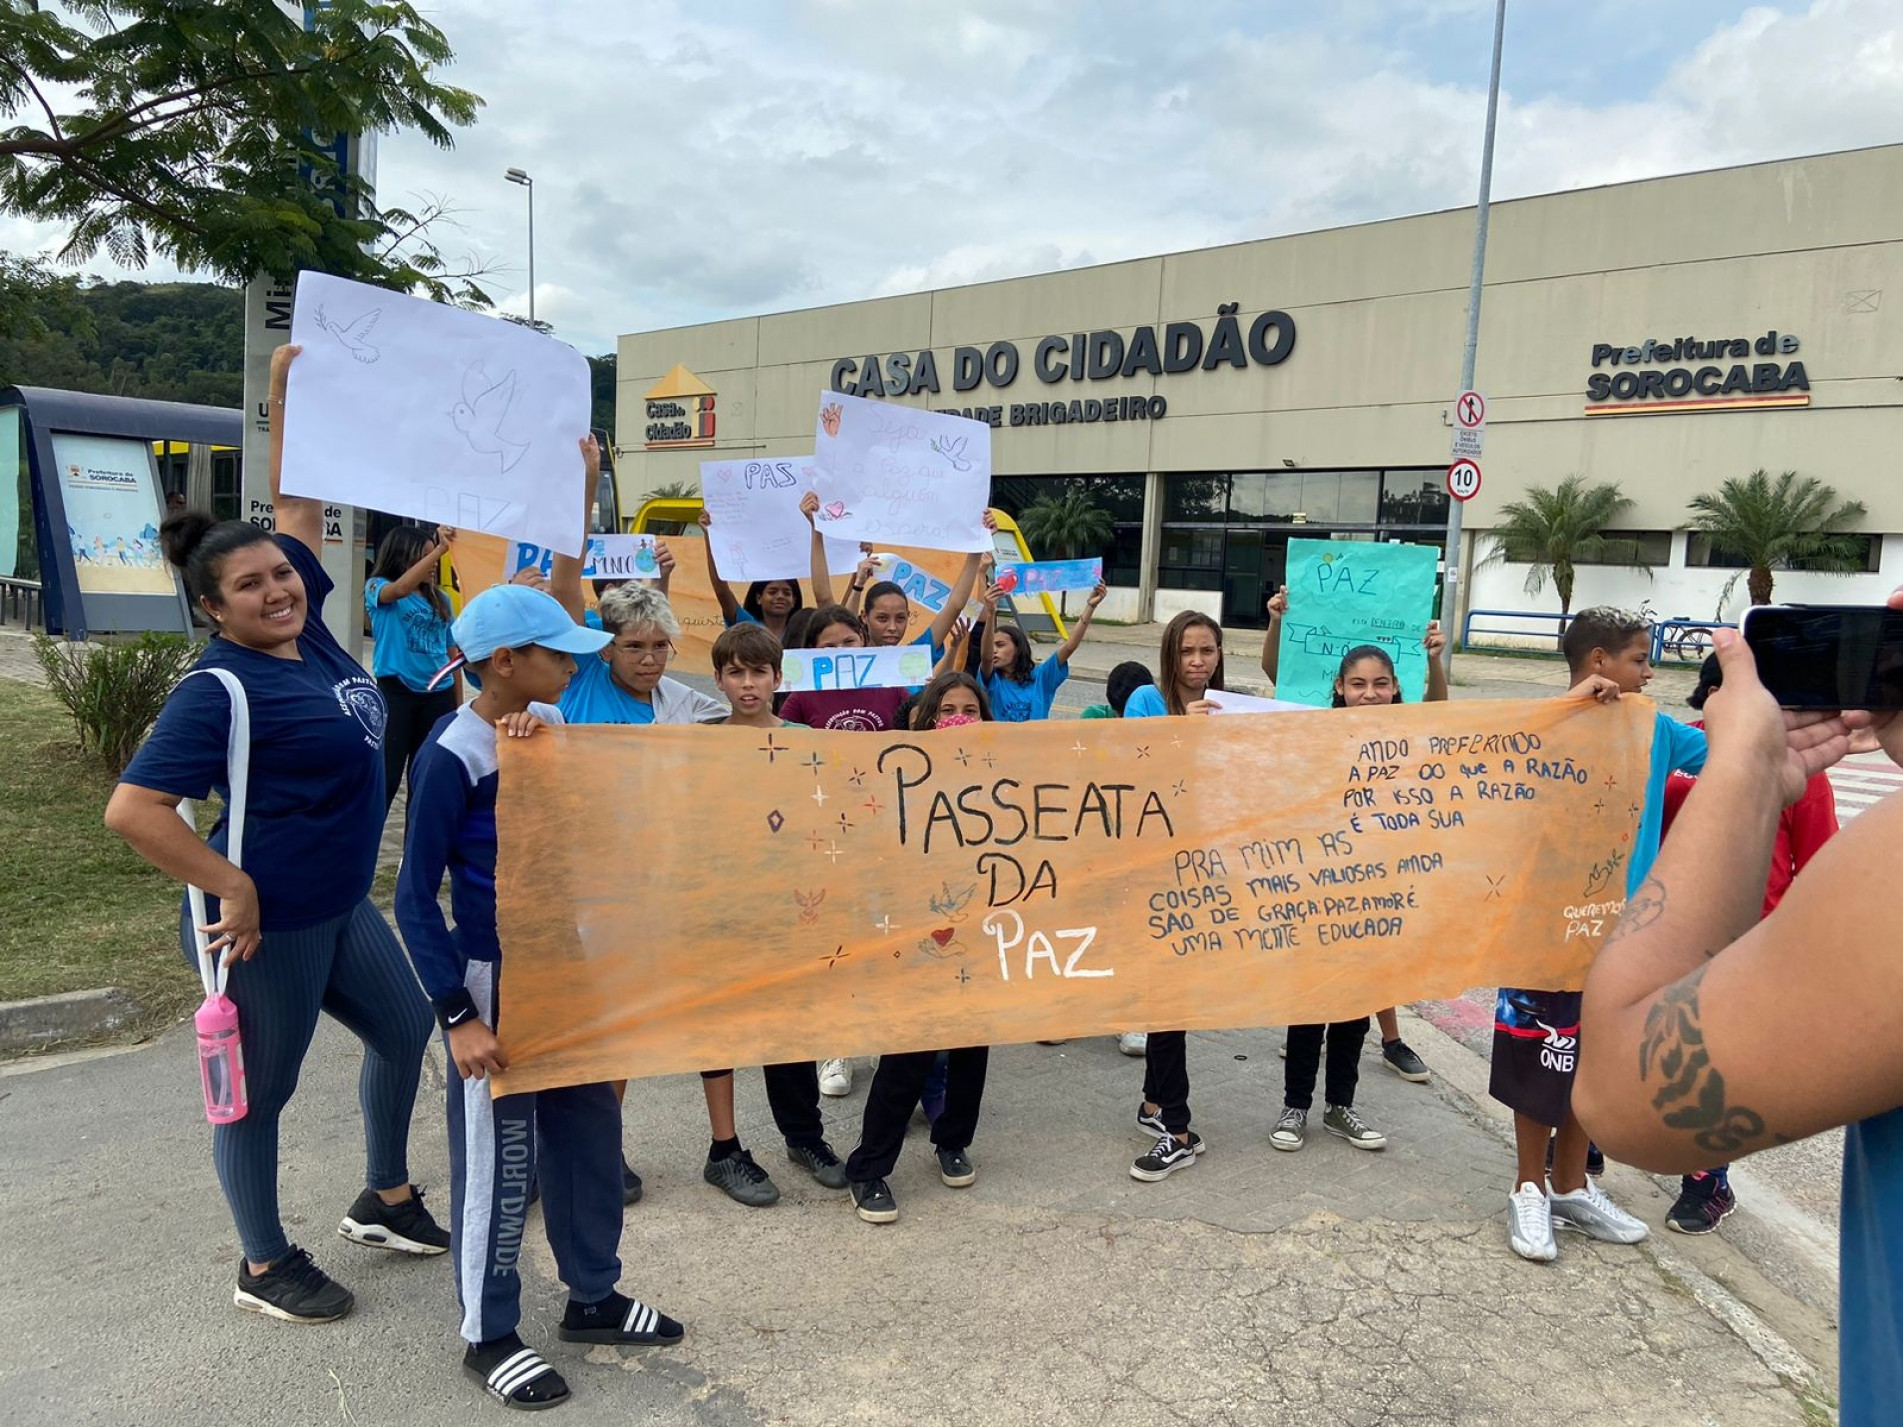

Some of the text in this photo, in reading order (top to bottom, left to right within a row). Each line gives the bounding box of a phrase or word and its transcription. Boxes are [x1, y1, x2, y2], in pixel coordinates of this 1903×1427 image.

[830, 302, 1296, 397] CASA DO CIDADÃO
[1591, 330, 1800, 367] Prefeitura de
[1586, 361, 1810, 402] SOROCABA
[646, 402, 677, 419] Casa
[1010, 395, 1167, 426] BRIGADEIRO
[90, 475, 137, 483] SOROCABA
[1455, 469, 1473, 487] 10
[593, 556, 634, 574] MUNDO
[1316, 563, 1380, 596] PAZ
[892, 562, 951, 611] PAZ
[812, 653, 881, 690] PAZ
[1358, 739, 1409, 762] ANDO
[1349, 765, 1361, 782] A
[1367, 764, 1400, 782] PAZ
[1503, 759, 1515, 774] A
[1526, 757, 1588, 785] RAZÃO
[876, 743, 1174, 854] PASSEATA
[1344, 780, 1535, 808] POR ISSO A RAZÃO
[1350, 809, 1465, 833] É TODA SUA
[1174, 849, 1227, 886] PRA
[1317, 830, 1353, 857] AS
[976, 852, 1057, 907] DA
[1149, 852, 1443, 912] COISAS MAIS VALIOSAS AINDA
[1209, 907, 1240, 924] DE
[1564, 919, 1604, 943] PAZ
[982, 908, 1115, 981] PAZ
[1172, 930, 1222, 956] UMA
[1318, 917, 1403, 945] EDUCADA
